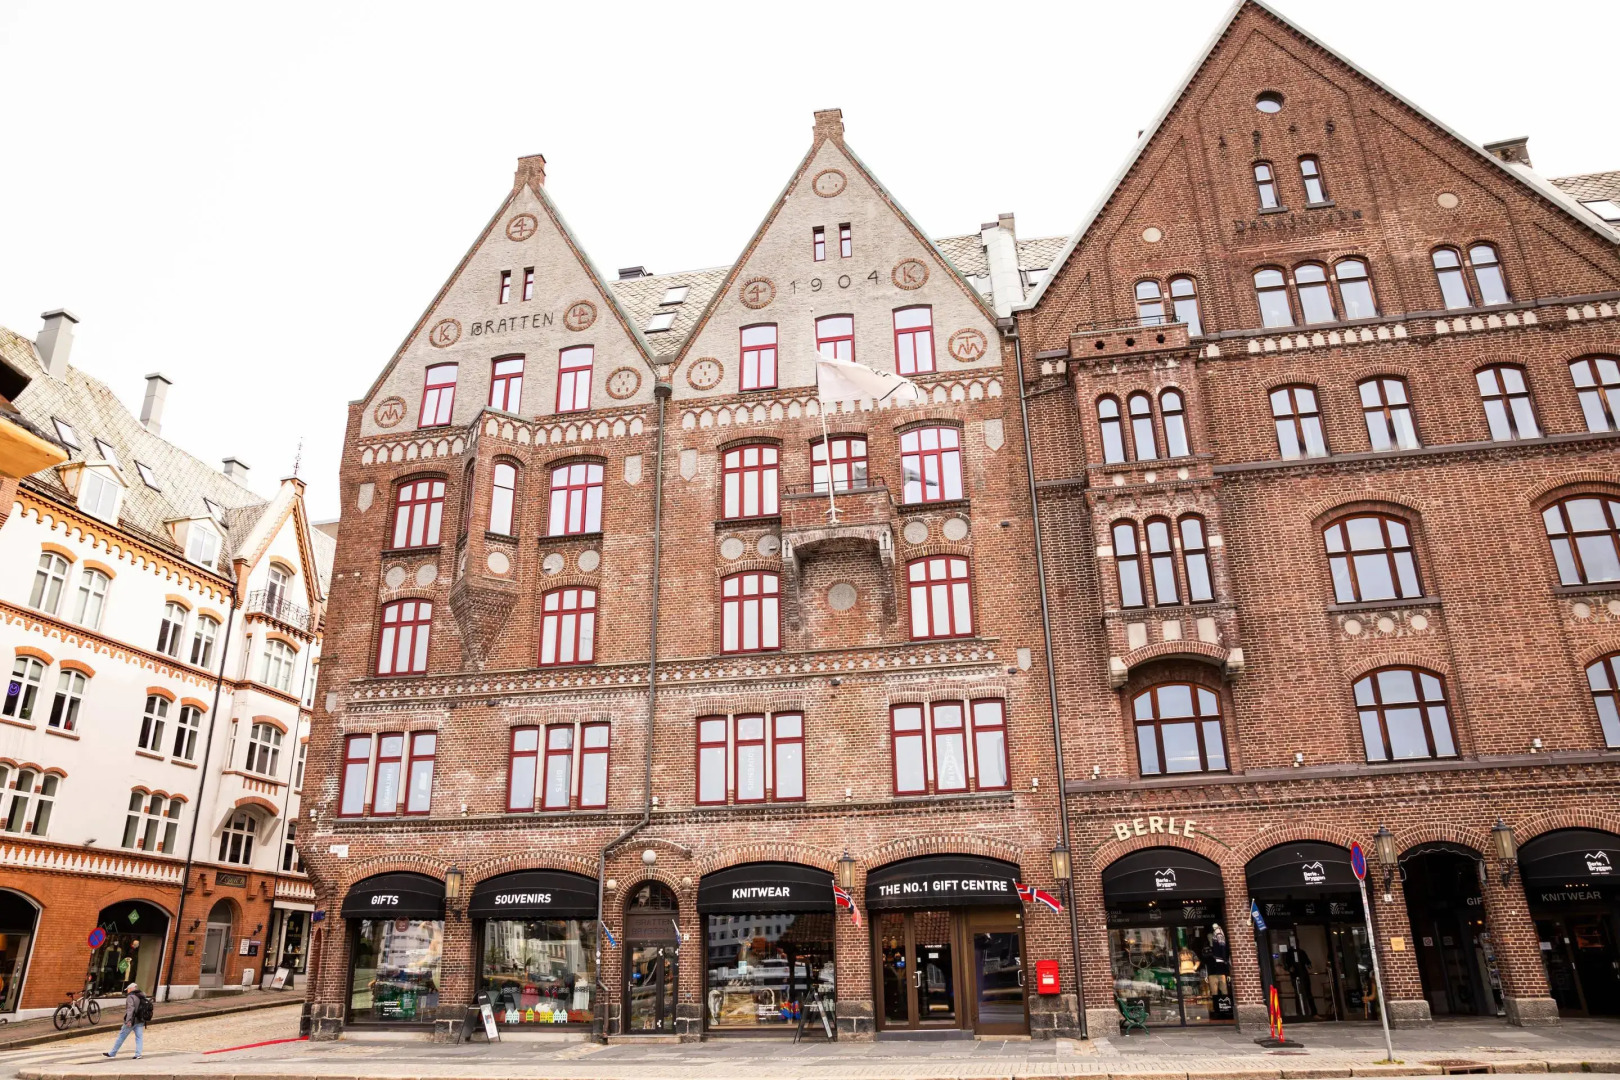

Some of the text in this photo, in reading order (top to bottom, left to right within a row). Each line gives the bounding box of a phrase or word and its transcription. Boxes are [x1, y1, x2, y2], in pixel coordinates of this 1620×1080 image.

[790, 269, 880, 295] 1904
[470, 312, 554, 336] BRATTEN
[1113, 815, 1197, 842] BERLE
[732, 886, 790, 899] KNITWEAR
[879, 879, 1008, 896] THE NO.1 GIFT CENTRE
[371, 894, 399, 905] GIFTS
[494, 892, 552, 905] SOUVENIRS
[1541, 891, 1602, 902] KNITWEAR
